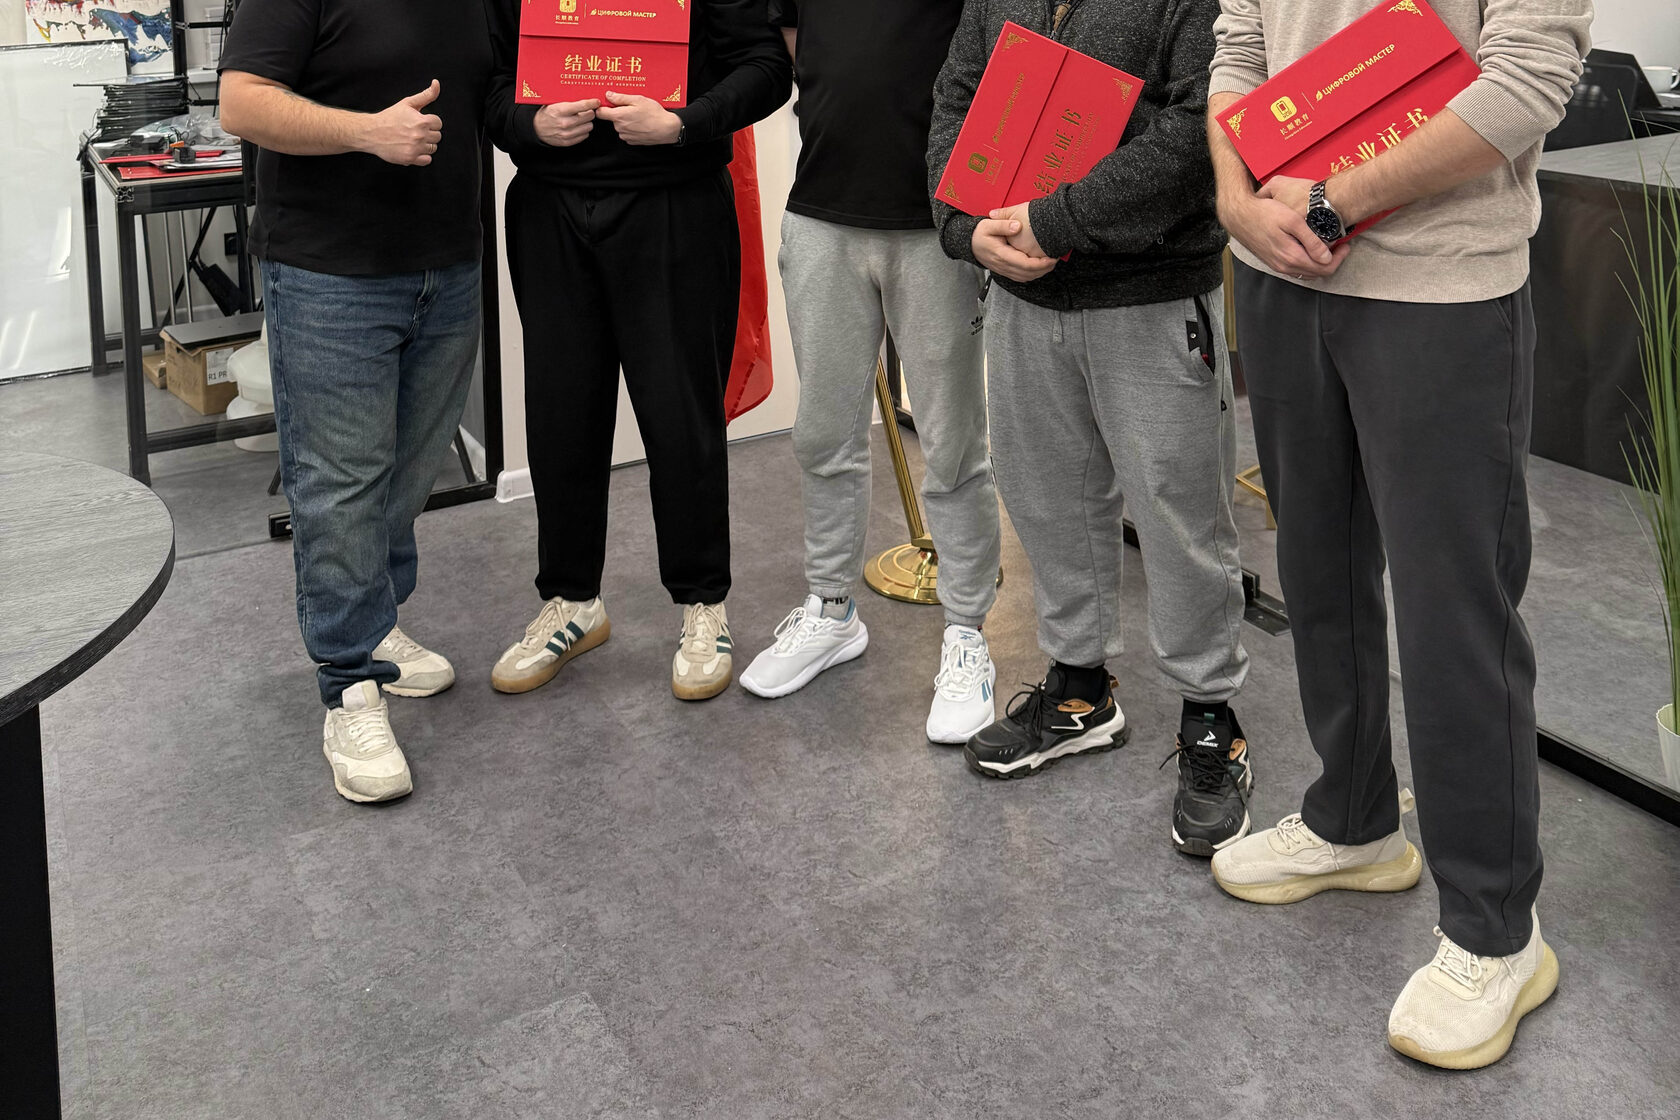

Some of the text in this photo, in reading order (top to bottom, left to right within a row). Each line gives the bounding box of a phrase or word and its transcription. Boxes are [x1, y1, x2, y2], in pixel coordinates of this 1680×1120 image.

[564, 54, 642, 74] 结业证书
[1321, 43, 1396, 96] ЦИФРОВОЙ МАСТЕР
[560, 73, 599, 81] CERTIFICATE
[608, 75, 647, 83] COMPLETION
